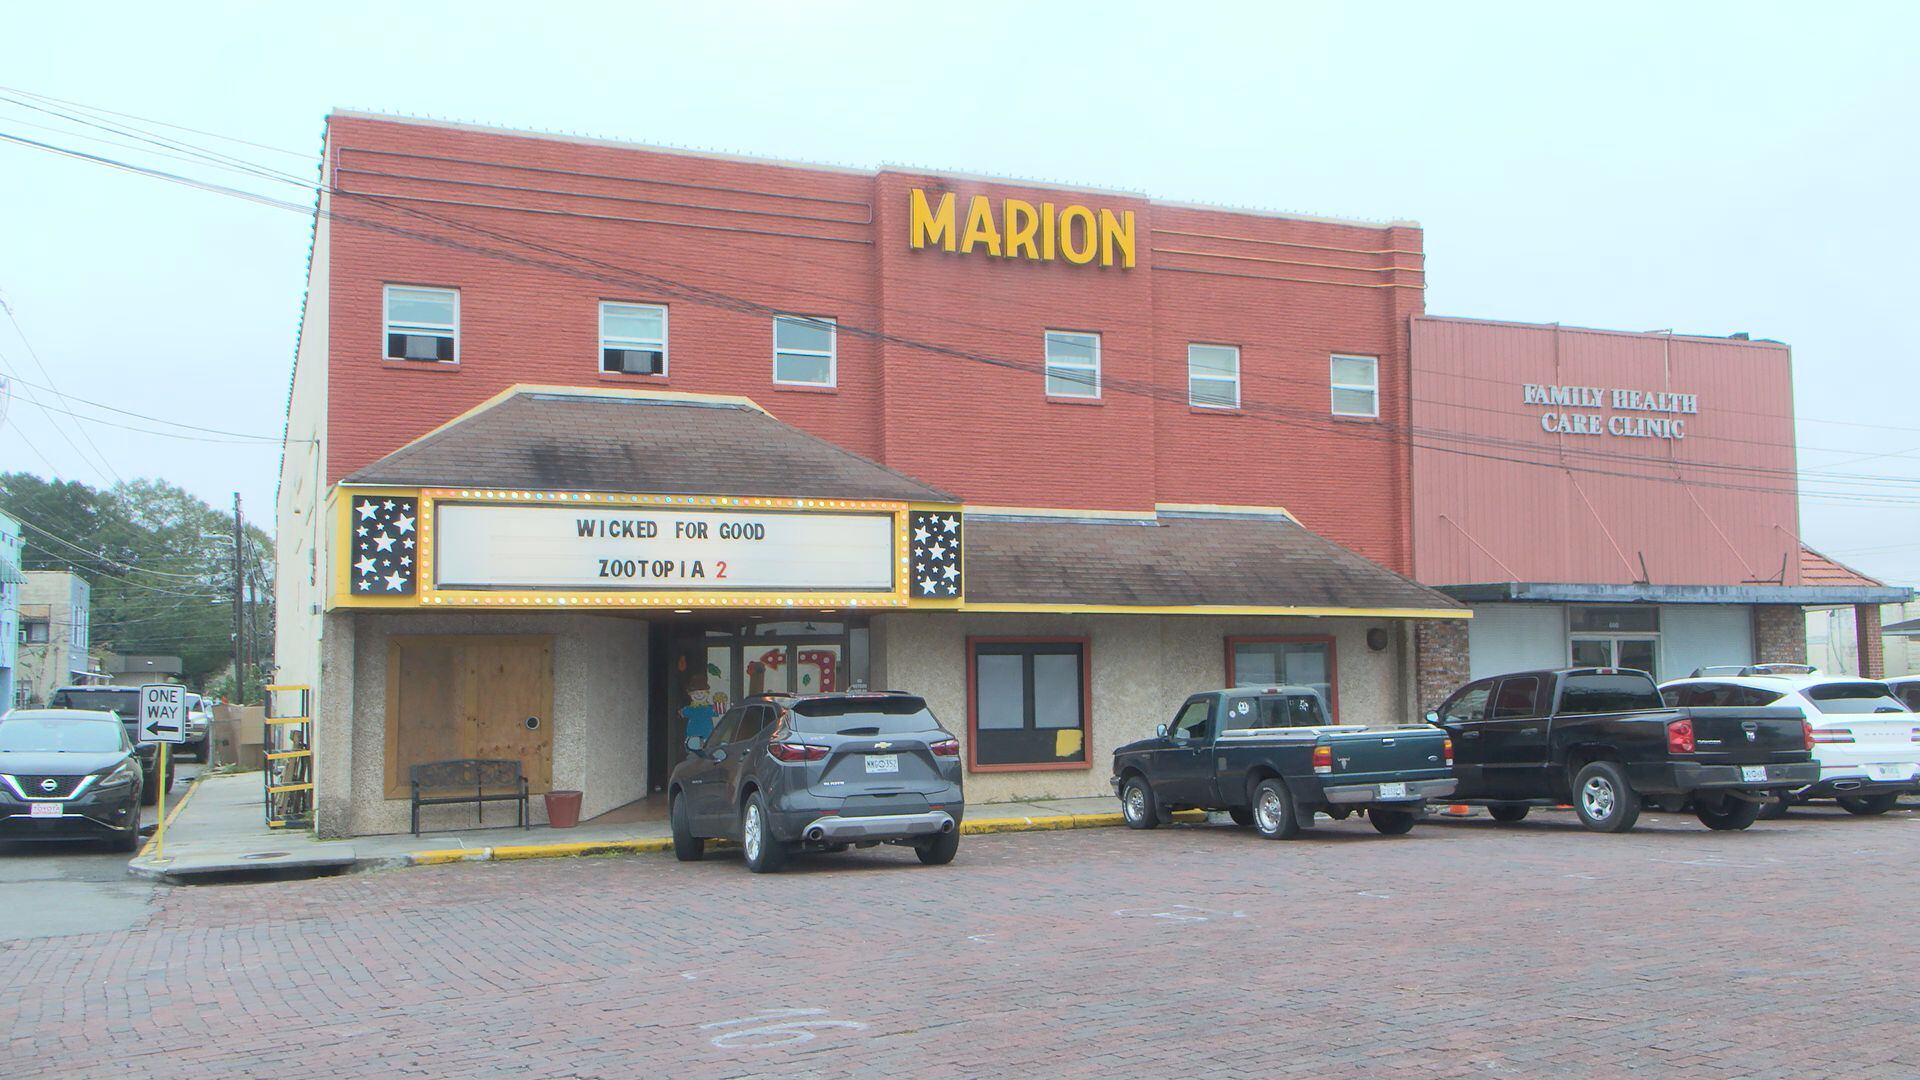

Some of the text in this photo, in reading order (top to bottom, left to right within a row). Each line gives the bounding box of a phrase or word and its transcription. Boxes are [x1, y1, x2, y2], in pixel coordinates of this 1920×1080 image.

[909, 188, 1136, 269] MARION
[1523, 383, 1697, 414] FAMILY HEALTH
[1541, 412, 1685, 440] CARE CLINIC
[576, 519, 765, 541] WICKED FOR GOOD
[599, 559, 727, 579] ZOOTOPIA 2
[149, 689, 178, 703] ONE
[147, 705, 178, 719] WAY
